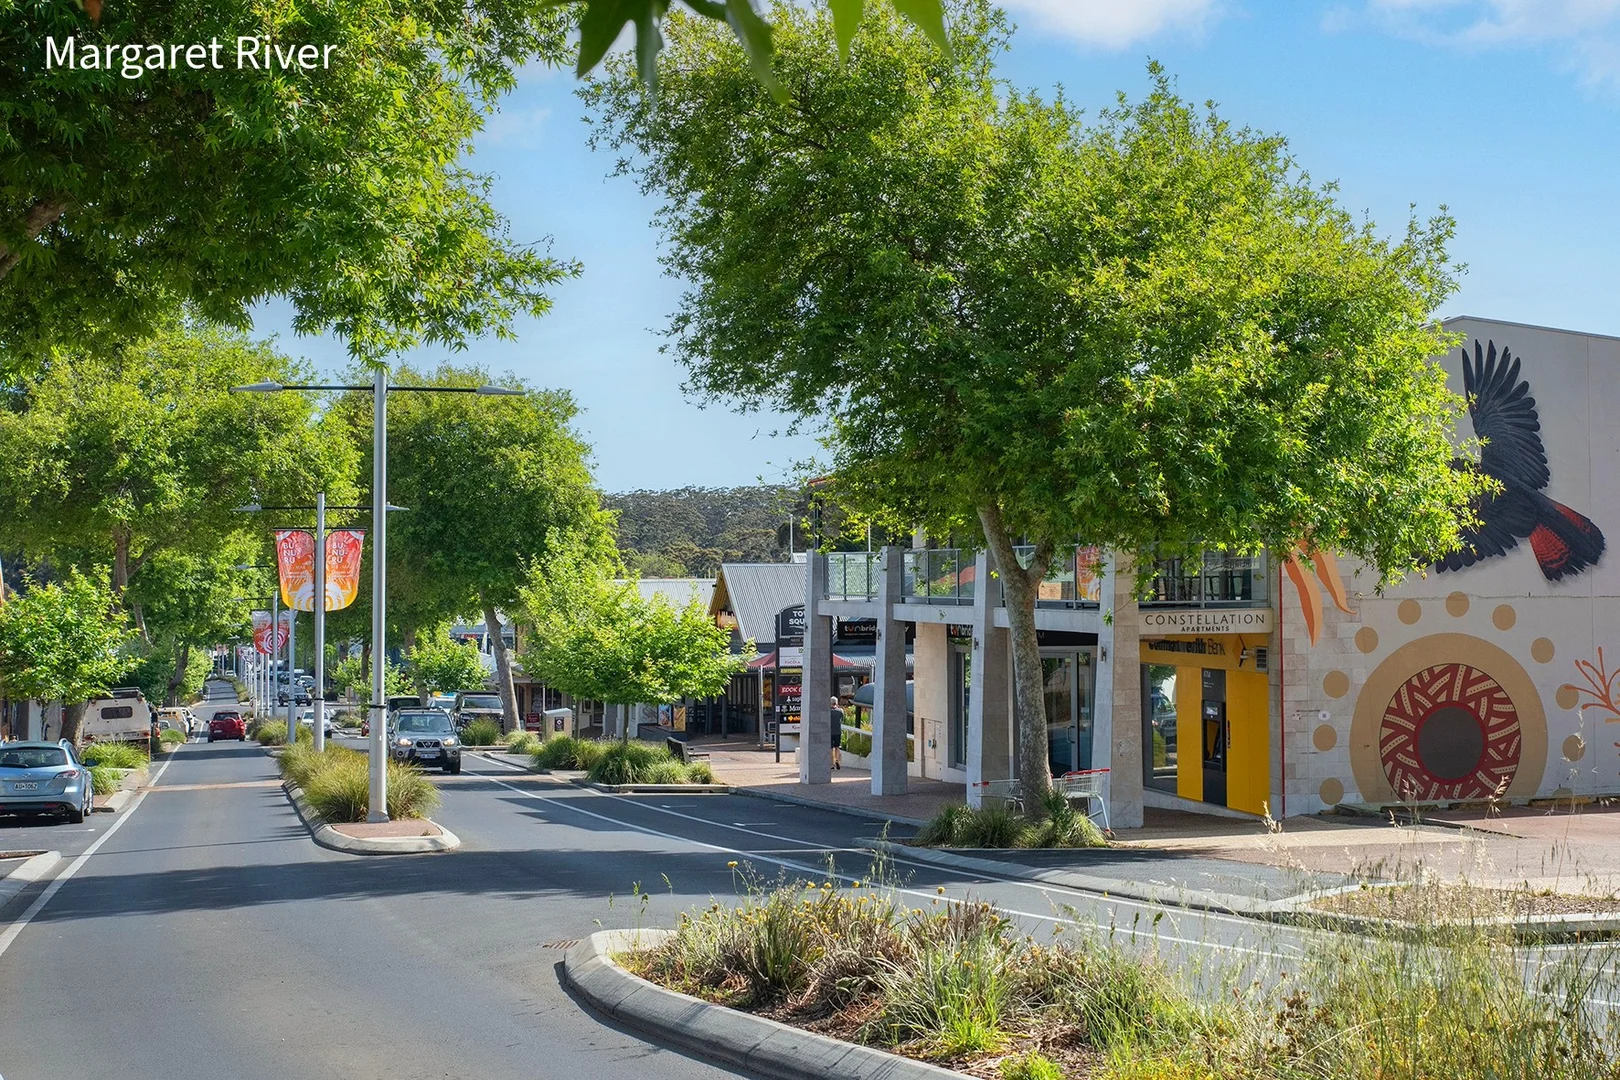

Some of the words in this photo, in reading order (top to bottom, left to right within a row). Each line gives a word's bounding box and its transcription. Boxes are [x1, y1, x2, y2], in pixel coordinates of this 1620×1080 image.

[283, 556, 295, 564] RU
[331, 556, 343, 564] RU
[788, 618, 805, 626] SQU
[1145, 613, 1265, 626] CONSTELLATION
[844, 624, 876, 632] tunbrid
